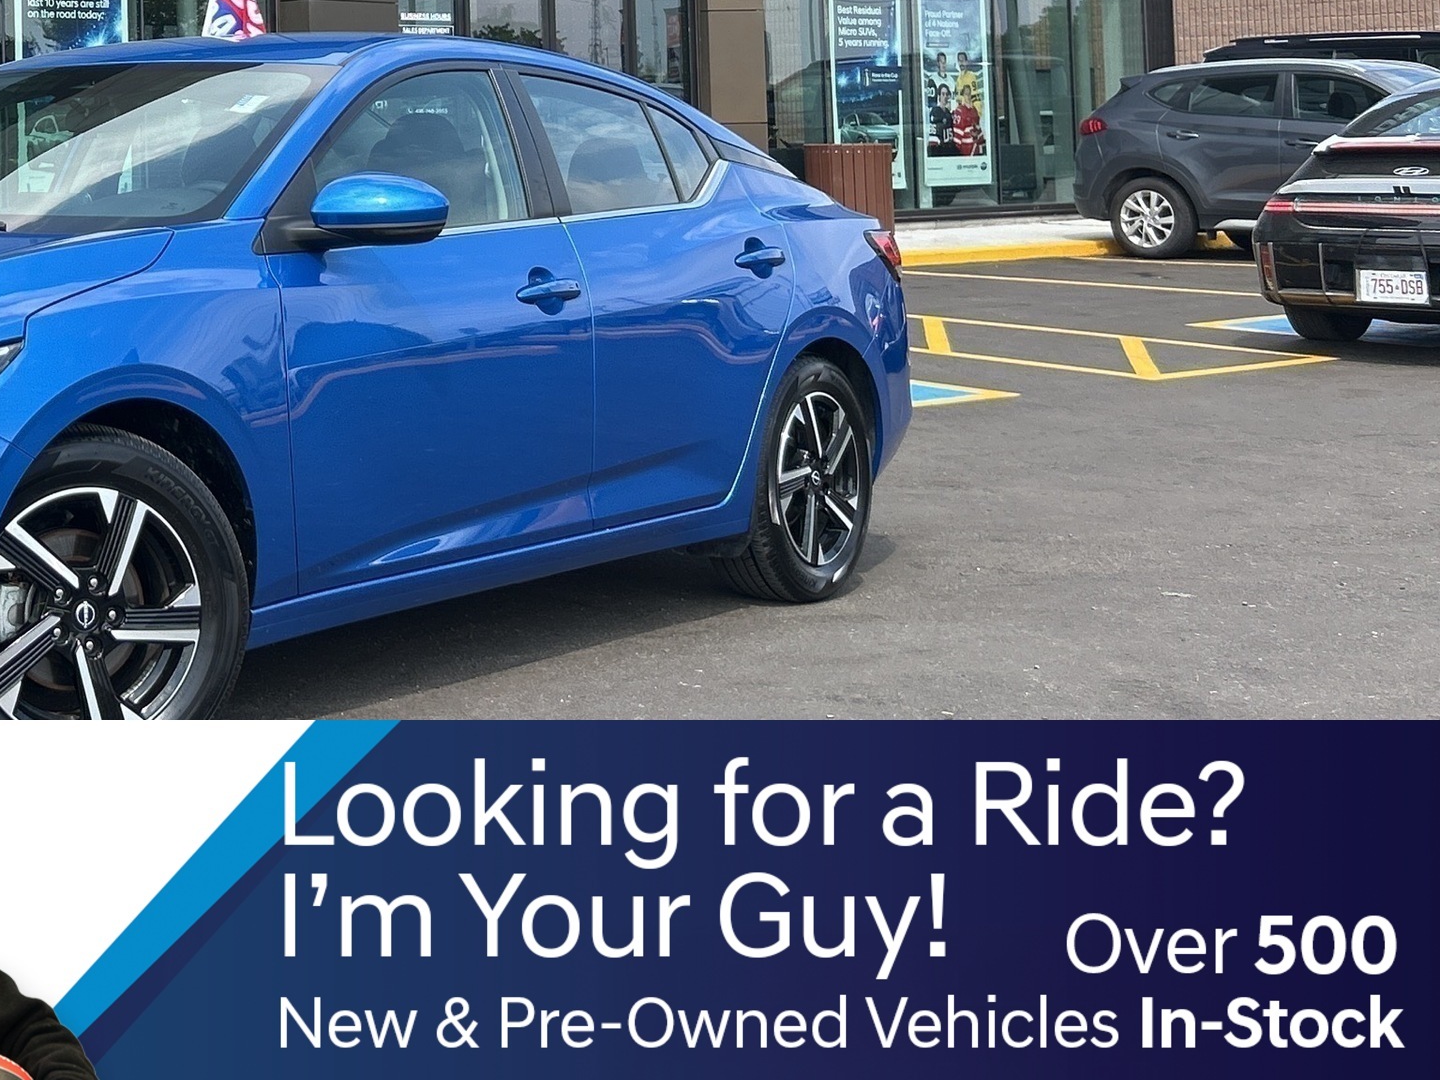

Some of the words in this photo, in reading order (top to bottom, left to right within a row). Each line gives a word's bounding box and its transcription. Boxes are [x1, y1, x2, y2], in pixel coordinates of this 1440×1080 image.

[56, 0, 79, 9] years
[80, 0, 94, 8] are
[95, 0, 110, 8] still
[27, 10, 39, 18] on
[40, 9, 55, 18] the
[56, 9, 76, 19] road
[837, 5, 852, 14] Best
[853, 5, 882, 15] Residual
[925, 10, 941, 18] Proud
[942, 10, 963, 18] Partner
[837, 16, 857, 25] Value
[858, 18, 881, 27] among
[838, 26, 857, 36] Micro
[858, 27, 877, 37] SUVs,
[838, 38, 844, 46] 5
[844, 39, 862, 48] years
[1371, 278, 1393, 294] 755
[1401, 279, 1423, 295] DSB
